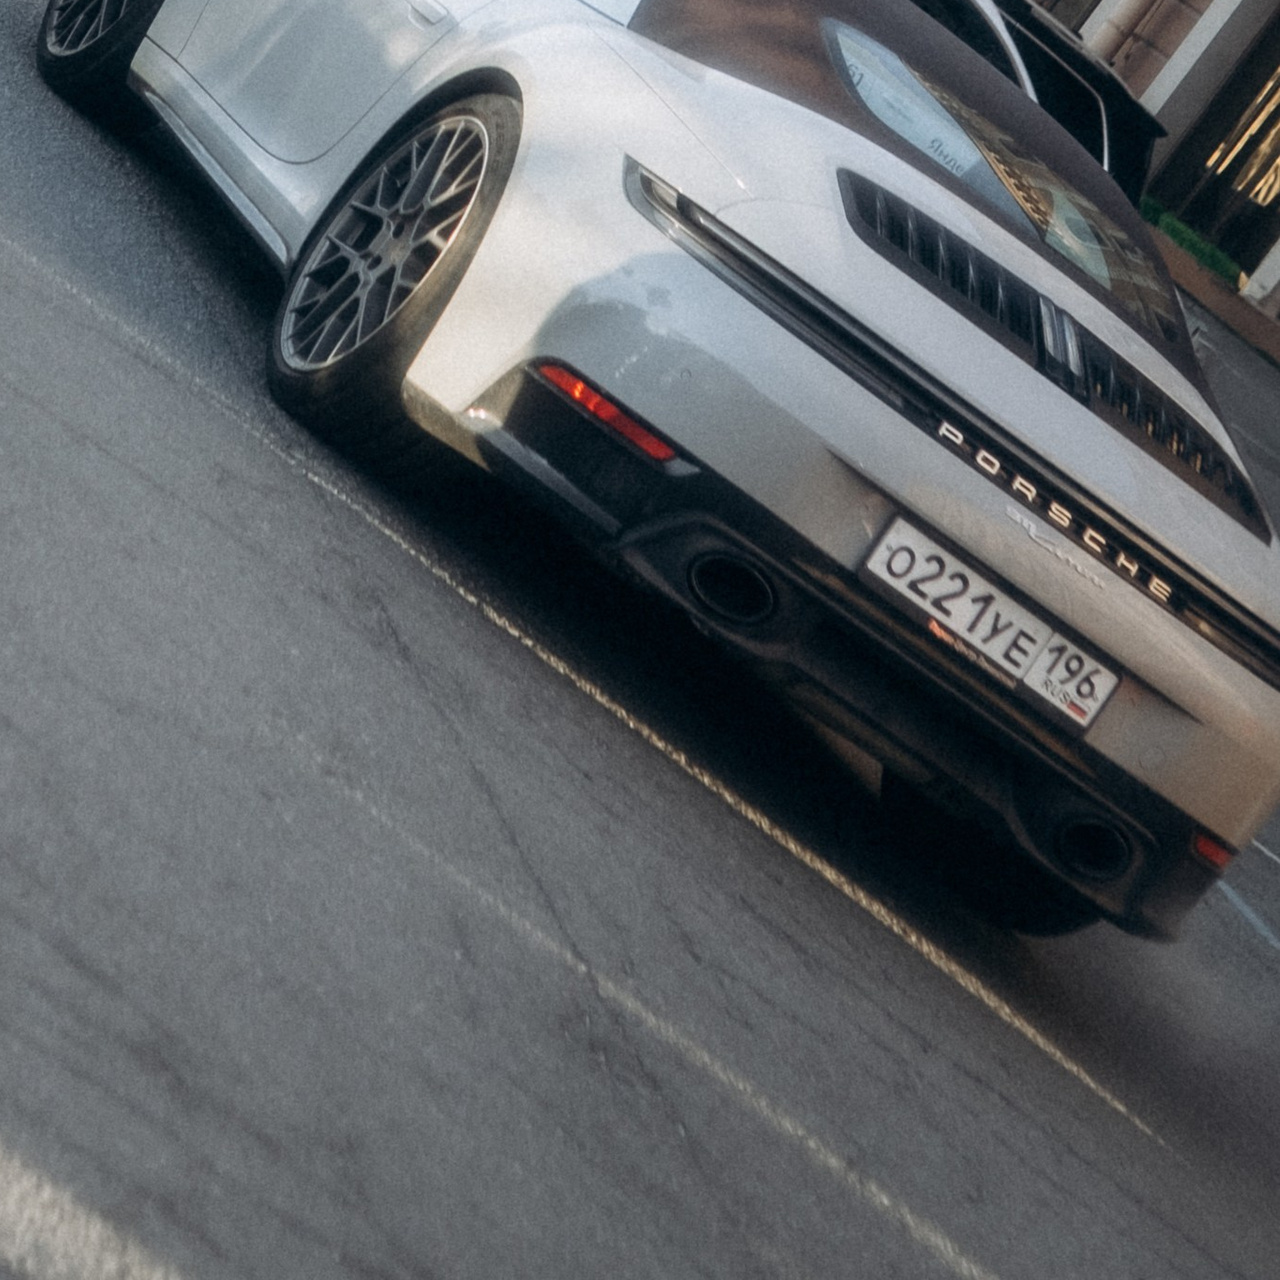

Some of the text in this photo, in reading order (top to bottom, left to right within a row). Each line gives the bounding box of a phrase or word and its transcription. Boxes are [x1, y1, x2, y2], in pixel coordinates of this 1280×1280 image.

[938, 420, 1172, 602] PORSCHE
[1042, 678, 1071, 705] RUS
[1046, 643, 1101, 700] 196
